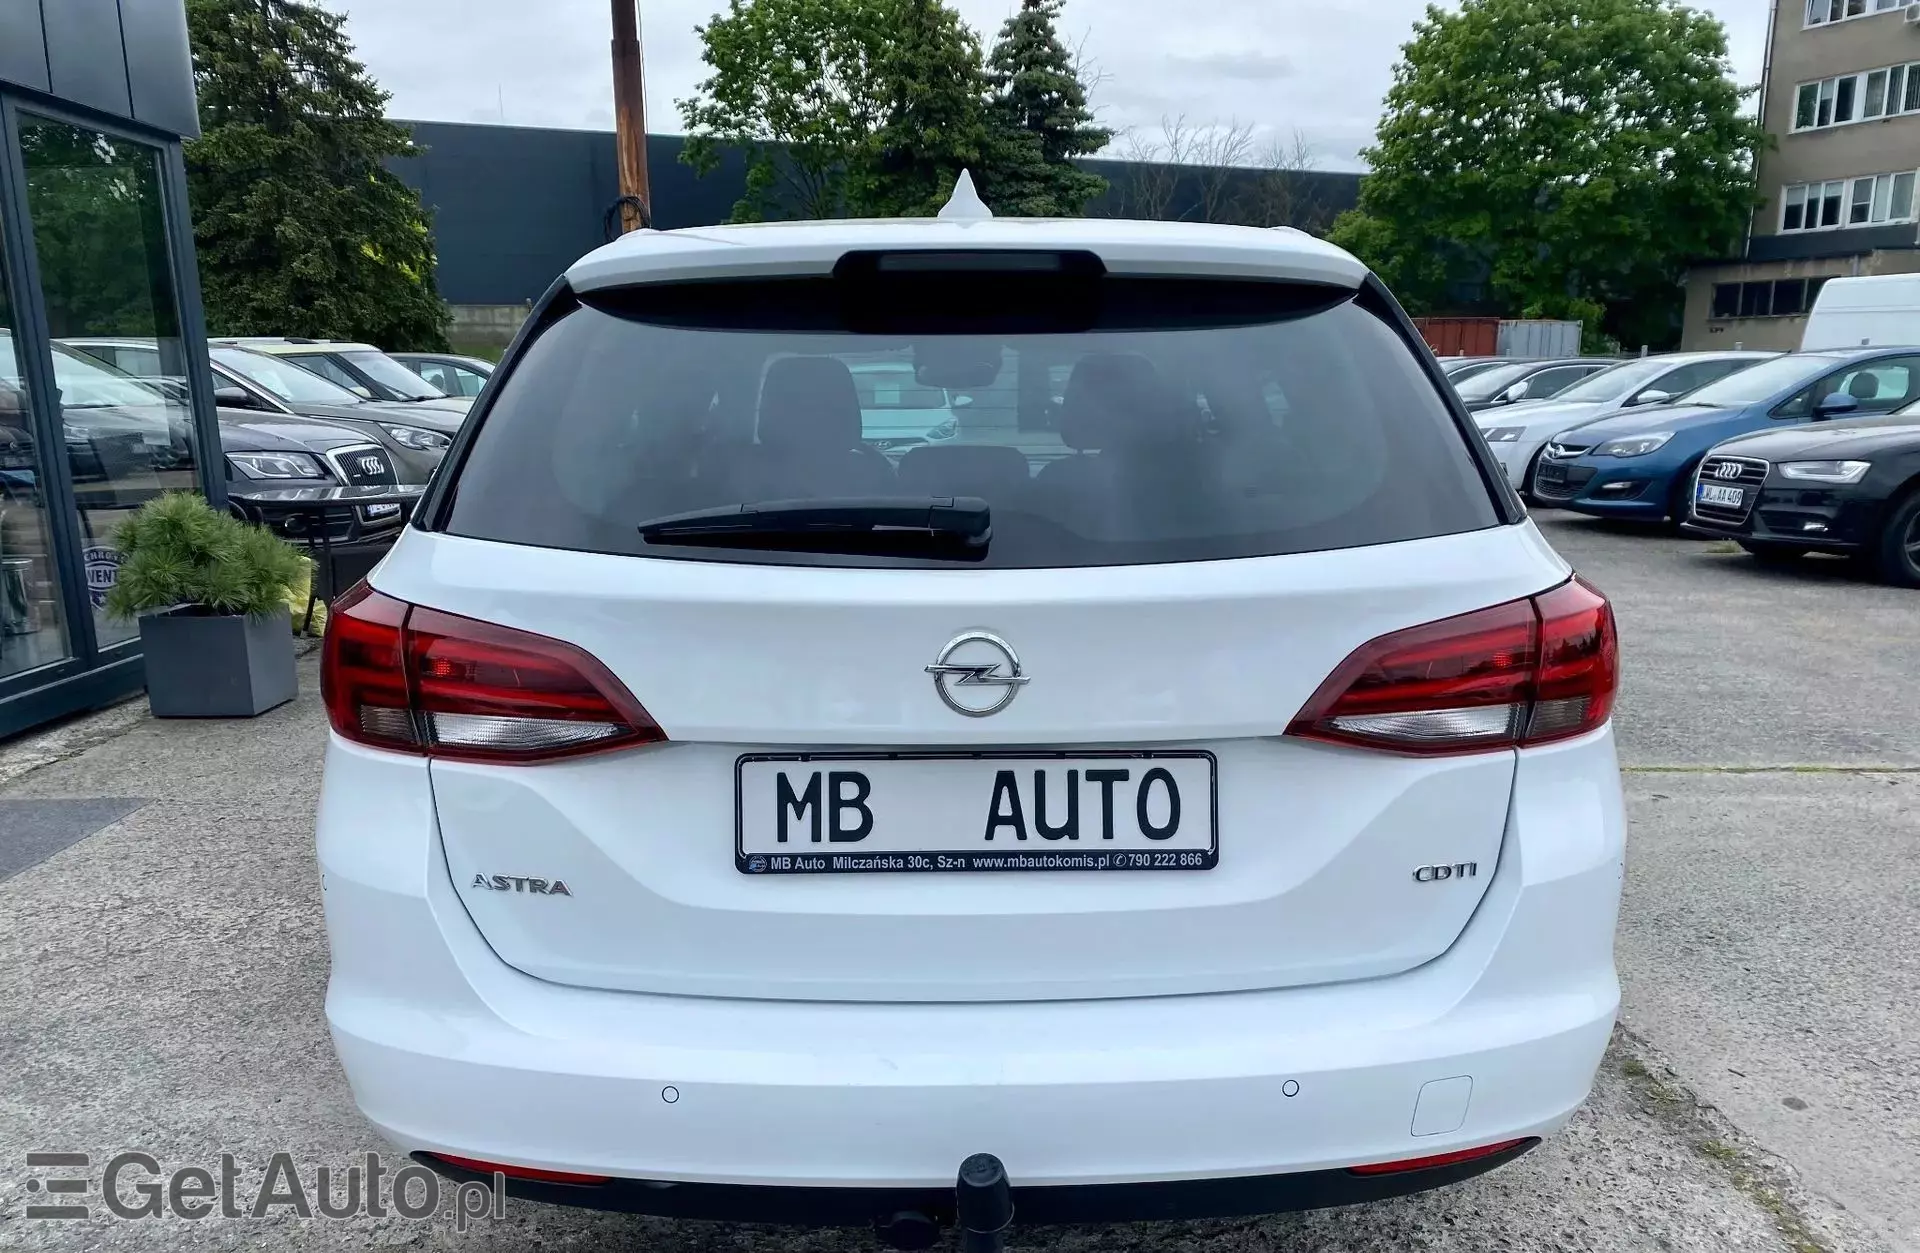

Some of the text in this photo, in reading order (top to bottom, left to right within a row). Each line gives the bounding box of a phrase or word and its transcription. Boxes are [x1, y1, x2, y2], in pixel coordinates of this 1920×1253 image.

[1727, 490, 1742, 504] 409
[776, 767, 1181, 843] MB AUTO
[771, 853, 1203, 870] MB Auto Milczańska 30c, Sz-n www.mbautokomis.pl 790 222 866
[1412, 862, 1477, 882] CDTI
[472, 872, 573, 897] ASTRA
